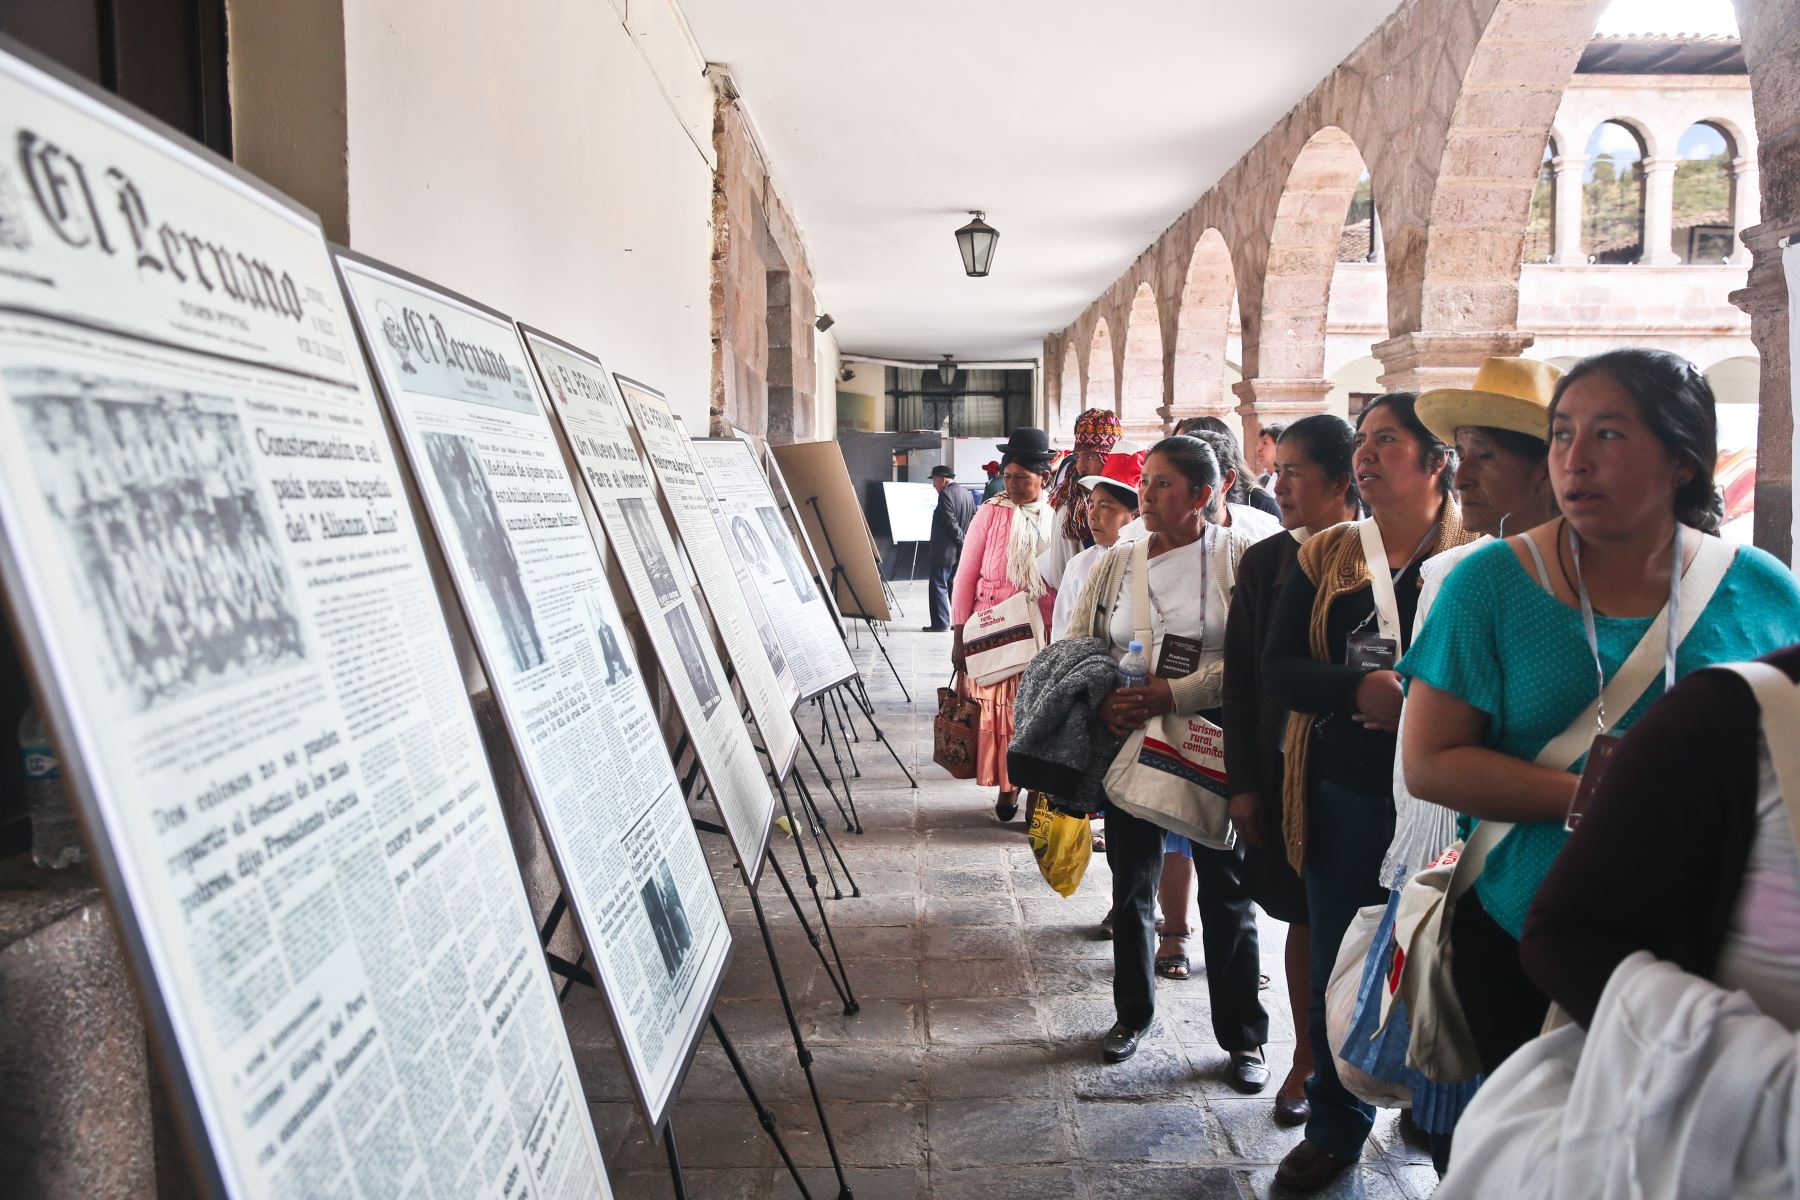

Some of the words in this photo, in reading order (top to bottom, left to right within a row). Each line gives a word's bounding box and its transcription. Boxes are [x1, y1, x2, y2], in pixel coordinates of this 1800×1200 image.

[17, 128, 115, 255] El
[104, 166, 305, 322] Peruano
[402, 306, 440, 364] El
[428, 313, 512, 384] Peruano
[558, 365, 579, 396] EL
[571, 369, 613, 407] PERUANO
[573, 434, 589, 457] Un
[589, 437, 616, 460] Nuevo
[613, 440, 638, 462] Mundo
[585, 466, 613, 489] Para
[612, 467, 621, 488] el
[619, 467, 649, 489] Hombre
[1188, 719, 1222, 738] turismo
[1191, 732, 1212, 746] rural
[1183, 741, 1224, 758] comunita
